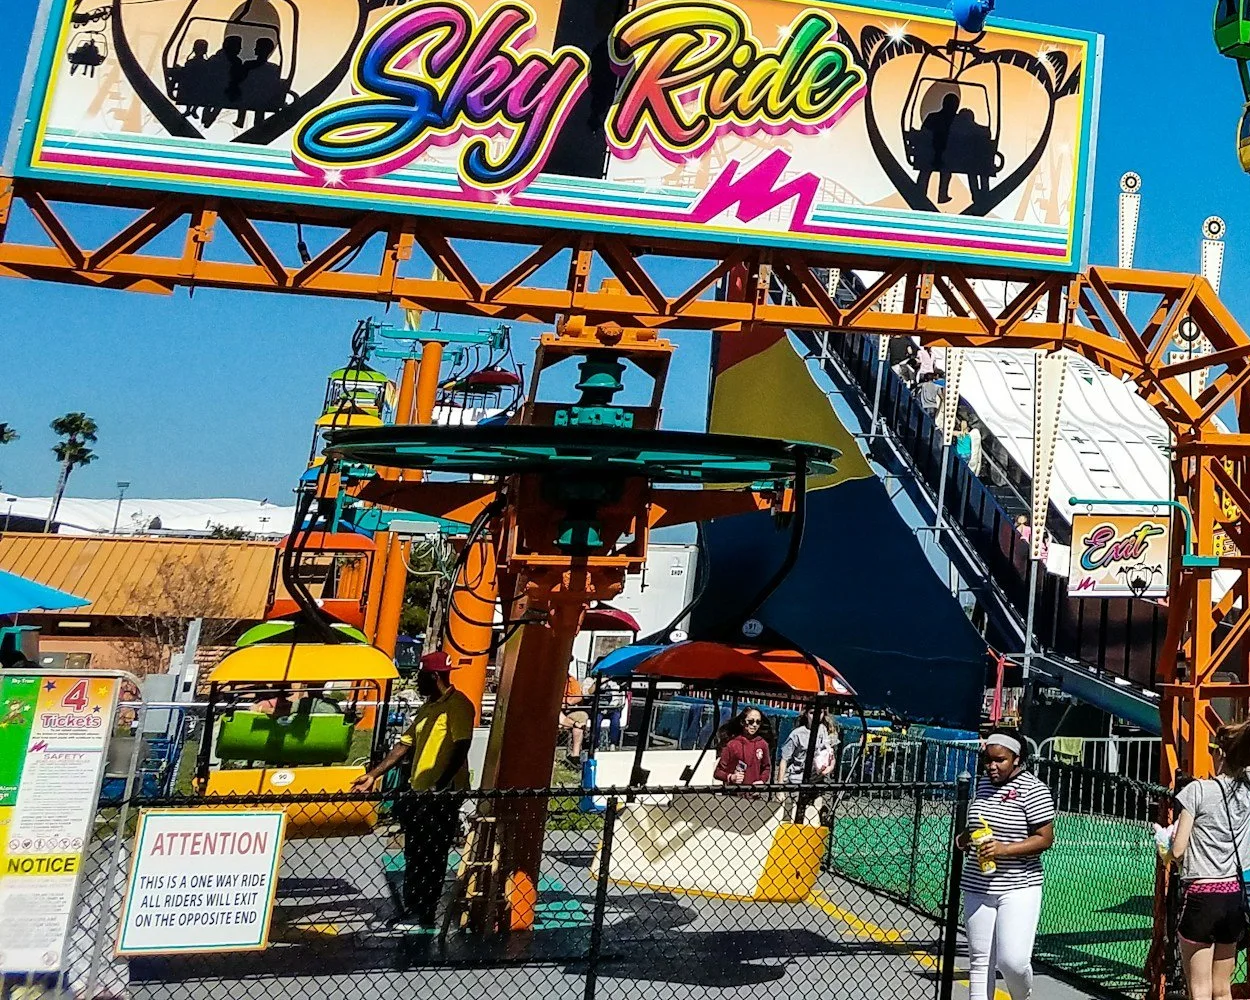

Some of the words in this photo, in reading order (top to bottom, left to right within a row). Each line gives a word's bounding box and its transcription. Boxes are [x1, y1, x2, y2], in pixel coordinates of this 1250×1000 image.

[1080, 525, 1164, 571] Exit
[62, 680, 88, 712] 4
[41, 714, 102, 728] Tickets
[150, 831, 268, 856] ATTENTION
[7, 857, 76, 873] NOTICE
[140, 875, 164, 889] THIS
[167, 875, 178, 889] IS
[179, 876, 187, 888] A
[190, 875, 213, 888] ONE
[215, 874, 239, 888] WAY
[241, 874, 267, 887] RIDE
[140, 895, 161, 908] ALL
[164, 894, 203, 908] RIDERS
[206, 893, 231, 907] WILL
[234, 892, 258, 906] EXIT
[135, 914, 152, 927] ON
[155, 913, 176, 927] THE
[178, 912, 233, 926] OPPOSITE
[234, 911, 257, 924] END
